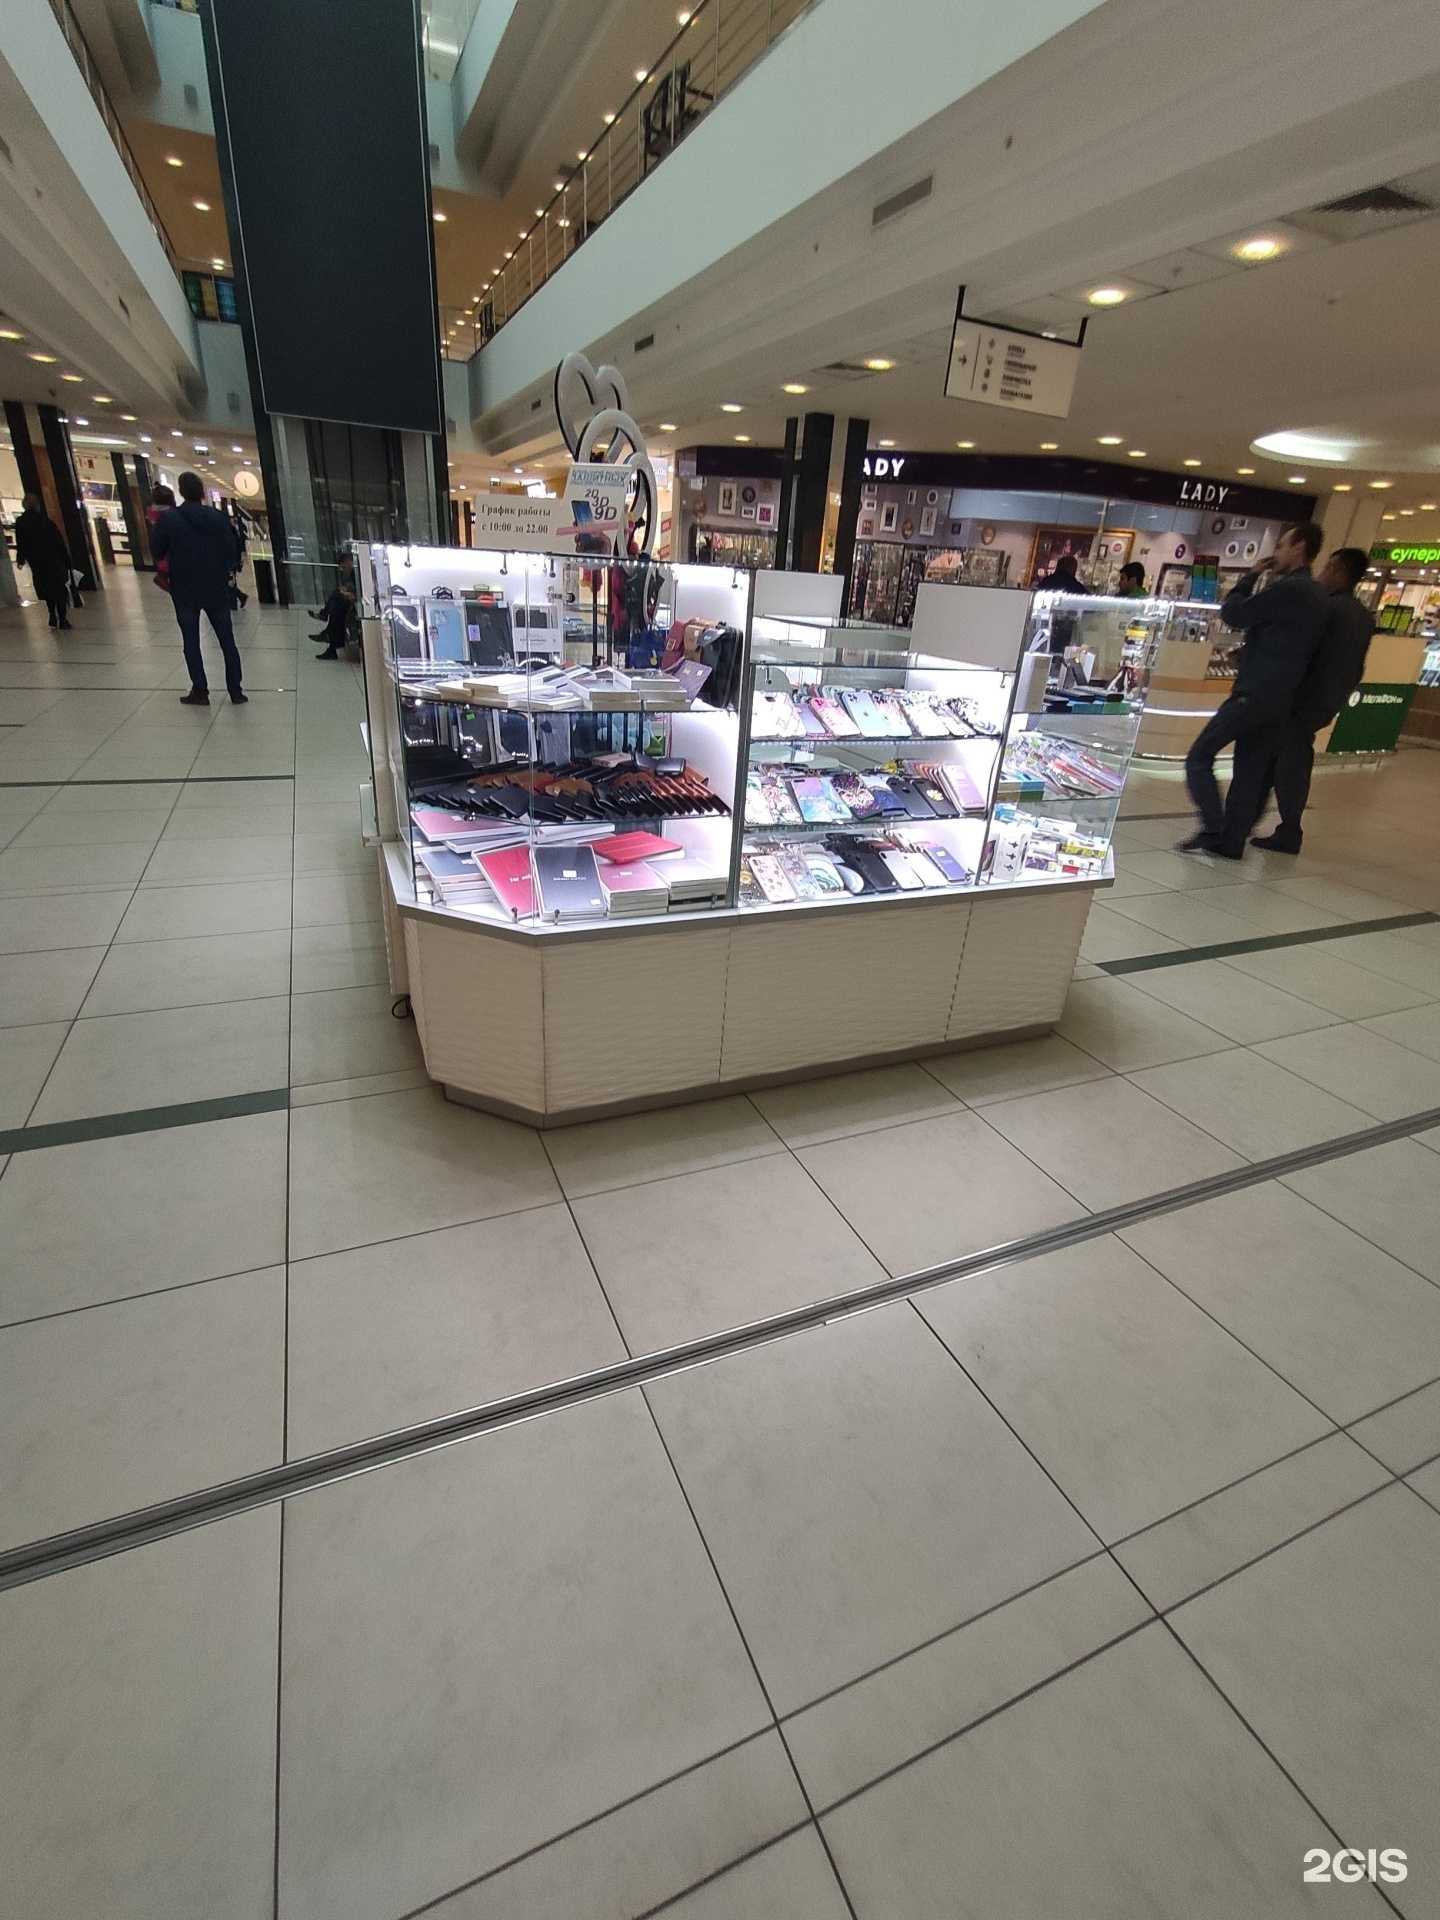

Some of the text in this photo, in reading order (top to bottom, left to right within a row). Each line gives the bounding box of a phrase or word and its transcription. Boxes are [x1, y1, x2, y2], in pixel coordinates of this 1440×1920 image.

[1180, 480, 1229, 504] LADY
[481, 503, 551, 517] График работы
[489, 522, 512, 531] 10:00
